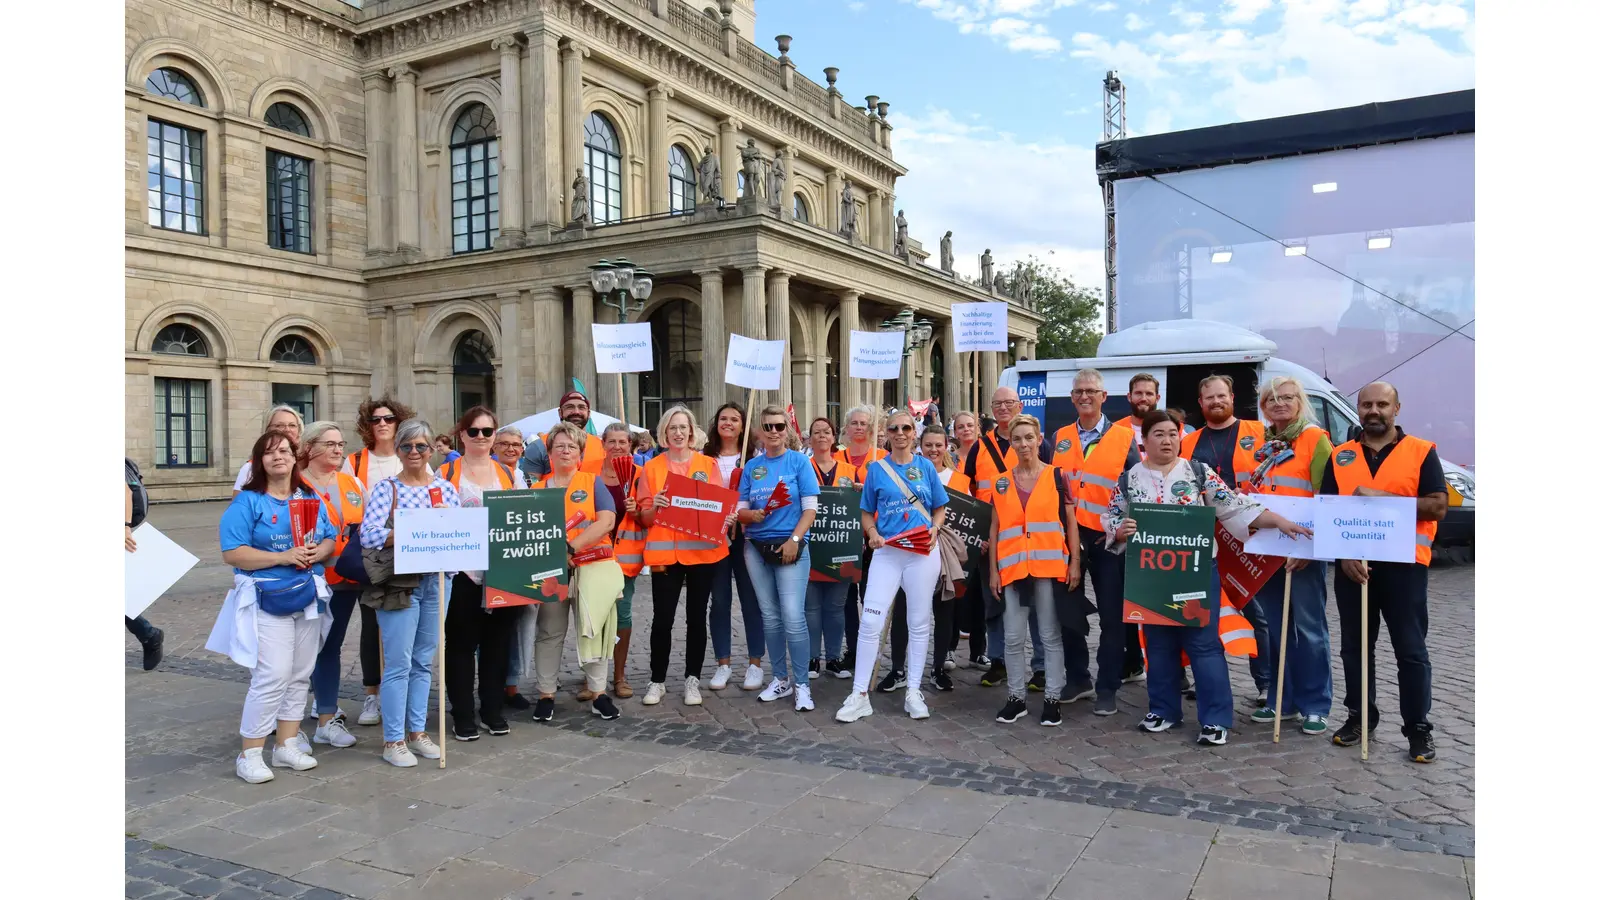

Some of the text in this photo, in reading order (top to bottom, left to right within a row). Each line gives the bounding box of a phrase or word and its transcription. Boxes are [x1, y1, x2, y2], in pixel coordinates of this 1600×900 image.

[1019, 386, 1037, 396] Die
[675, 498, 718, 510] #jetzthandeln
[816, 503, 848, 516] Es ist
[506, 510, 546, 525] Es ist
[811, 517, 860, 530] nf nach
[944, 507, 957, 521] Es
[958, 513, 976, 530] ist
[1333, 517, 1394, 528] Qualität statt
[411, 530, 471, 539] Wir brauchen
[488, 525, 562, 543] fünf nach
[810, 531, 849, 543] zwölf!
[1131, 531, 1210, 547] Alarmstufe
[1341, 530, 1386, 541] Quantität
[401, 543, 481, 554] Planungssicherheit
[502, 542, 550, 559] zwölf!
[1218, 528, 1263, 579] relevant!
[1140, 548, 1200, 572] ROT!
